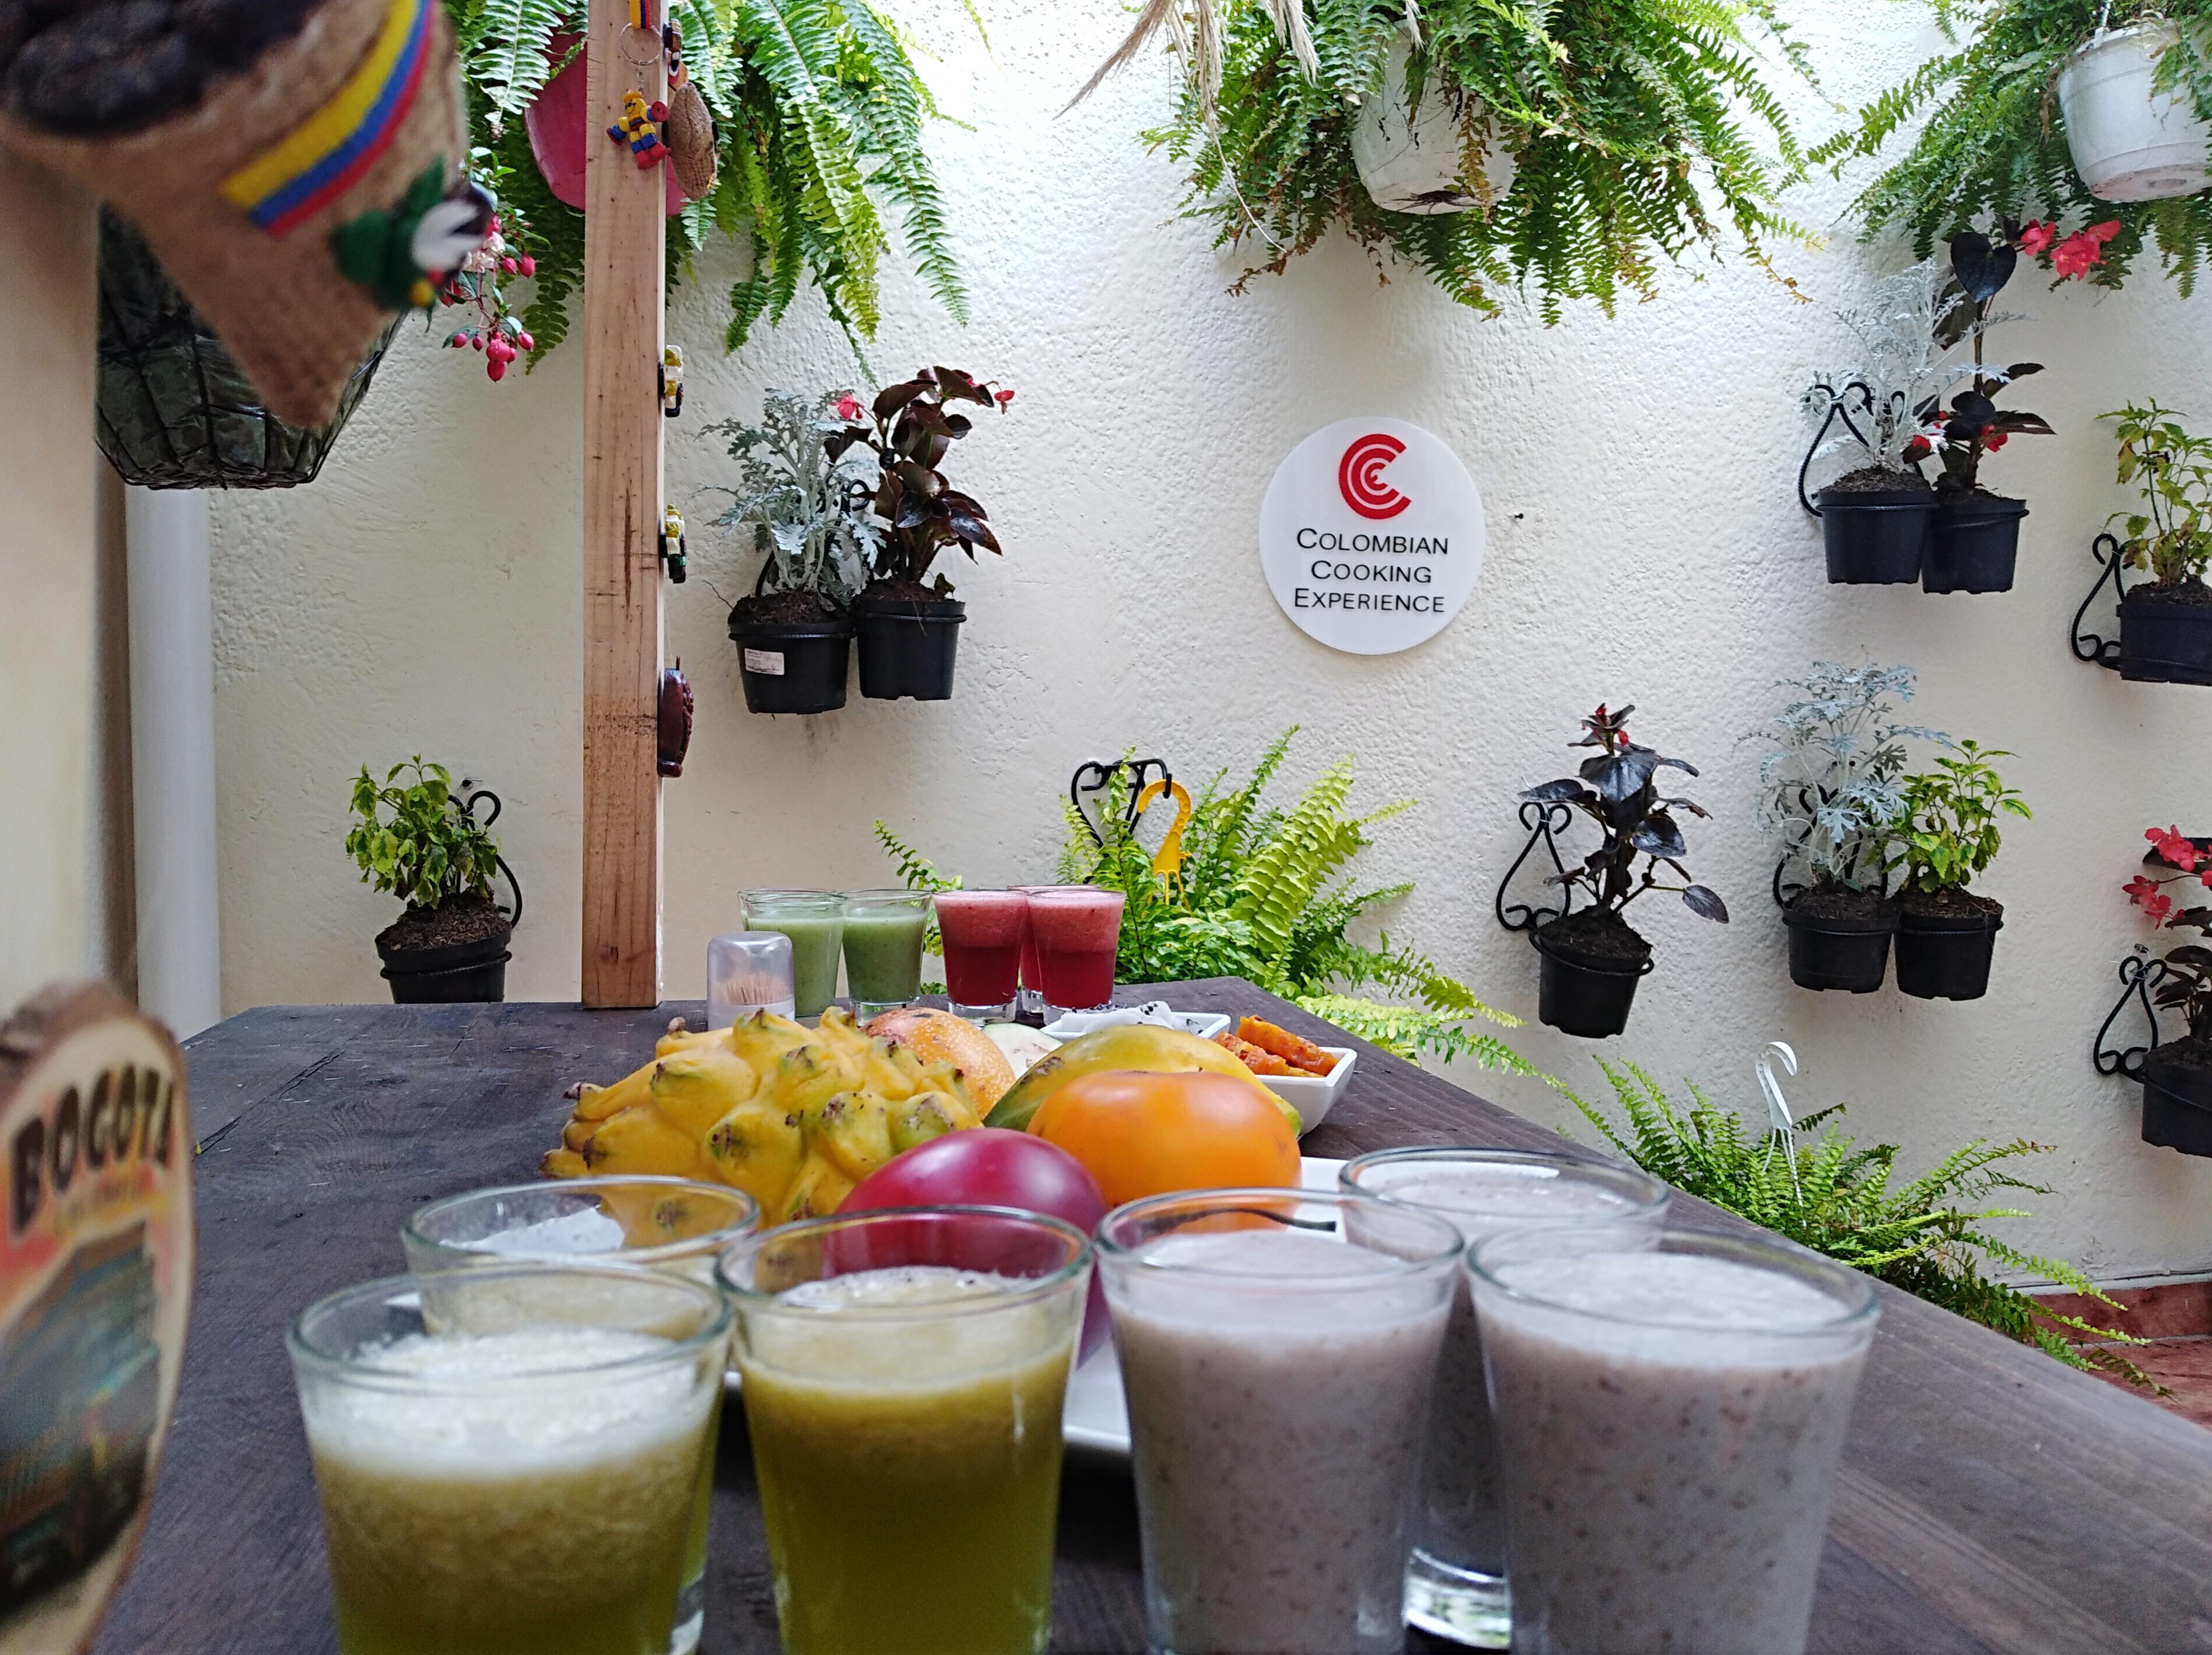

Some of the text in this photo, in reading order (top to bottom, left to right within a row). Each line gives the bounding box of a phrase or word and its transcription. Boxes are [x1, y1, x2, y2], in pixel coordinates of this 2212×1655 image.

[1296, 528, 1448, 555] COLOMBIAN
[1311, 560, 1431, 583] COOKING
[1294, 588, 1445, 613] EXPERIENCE
